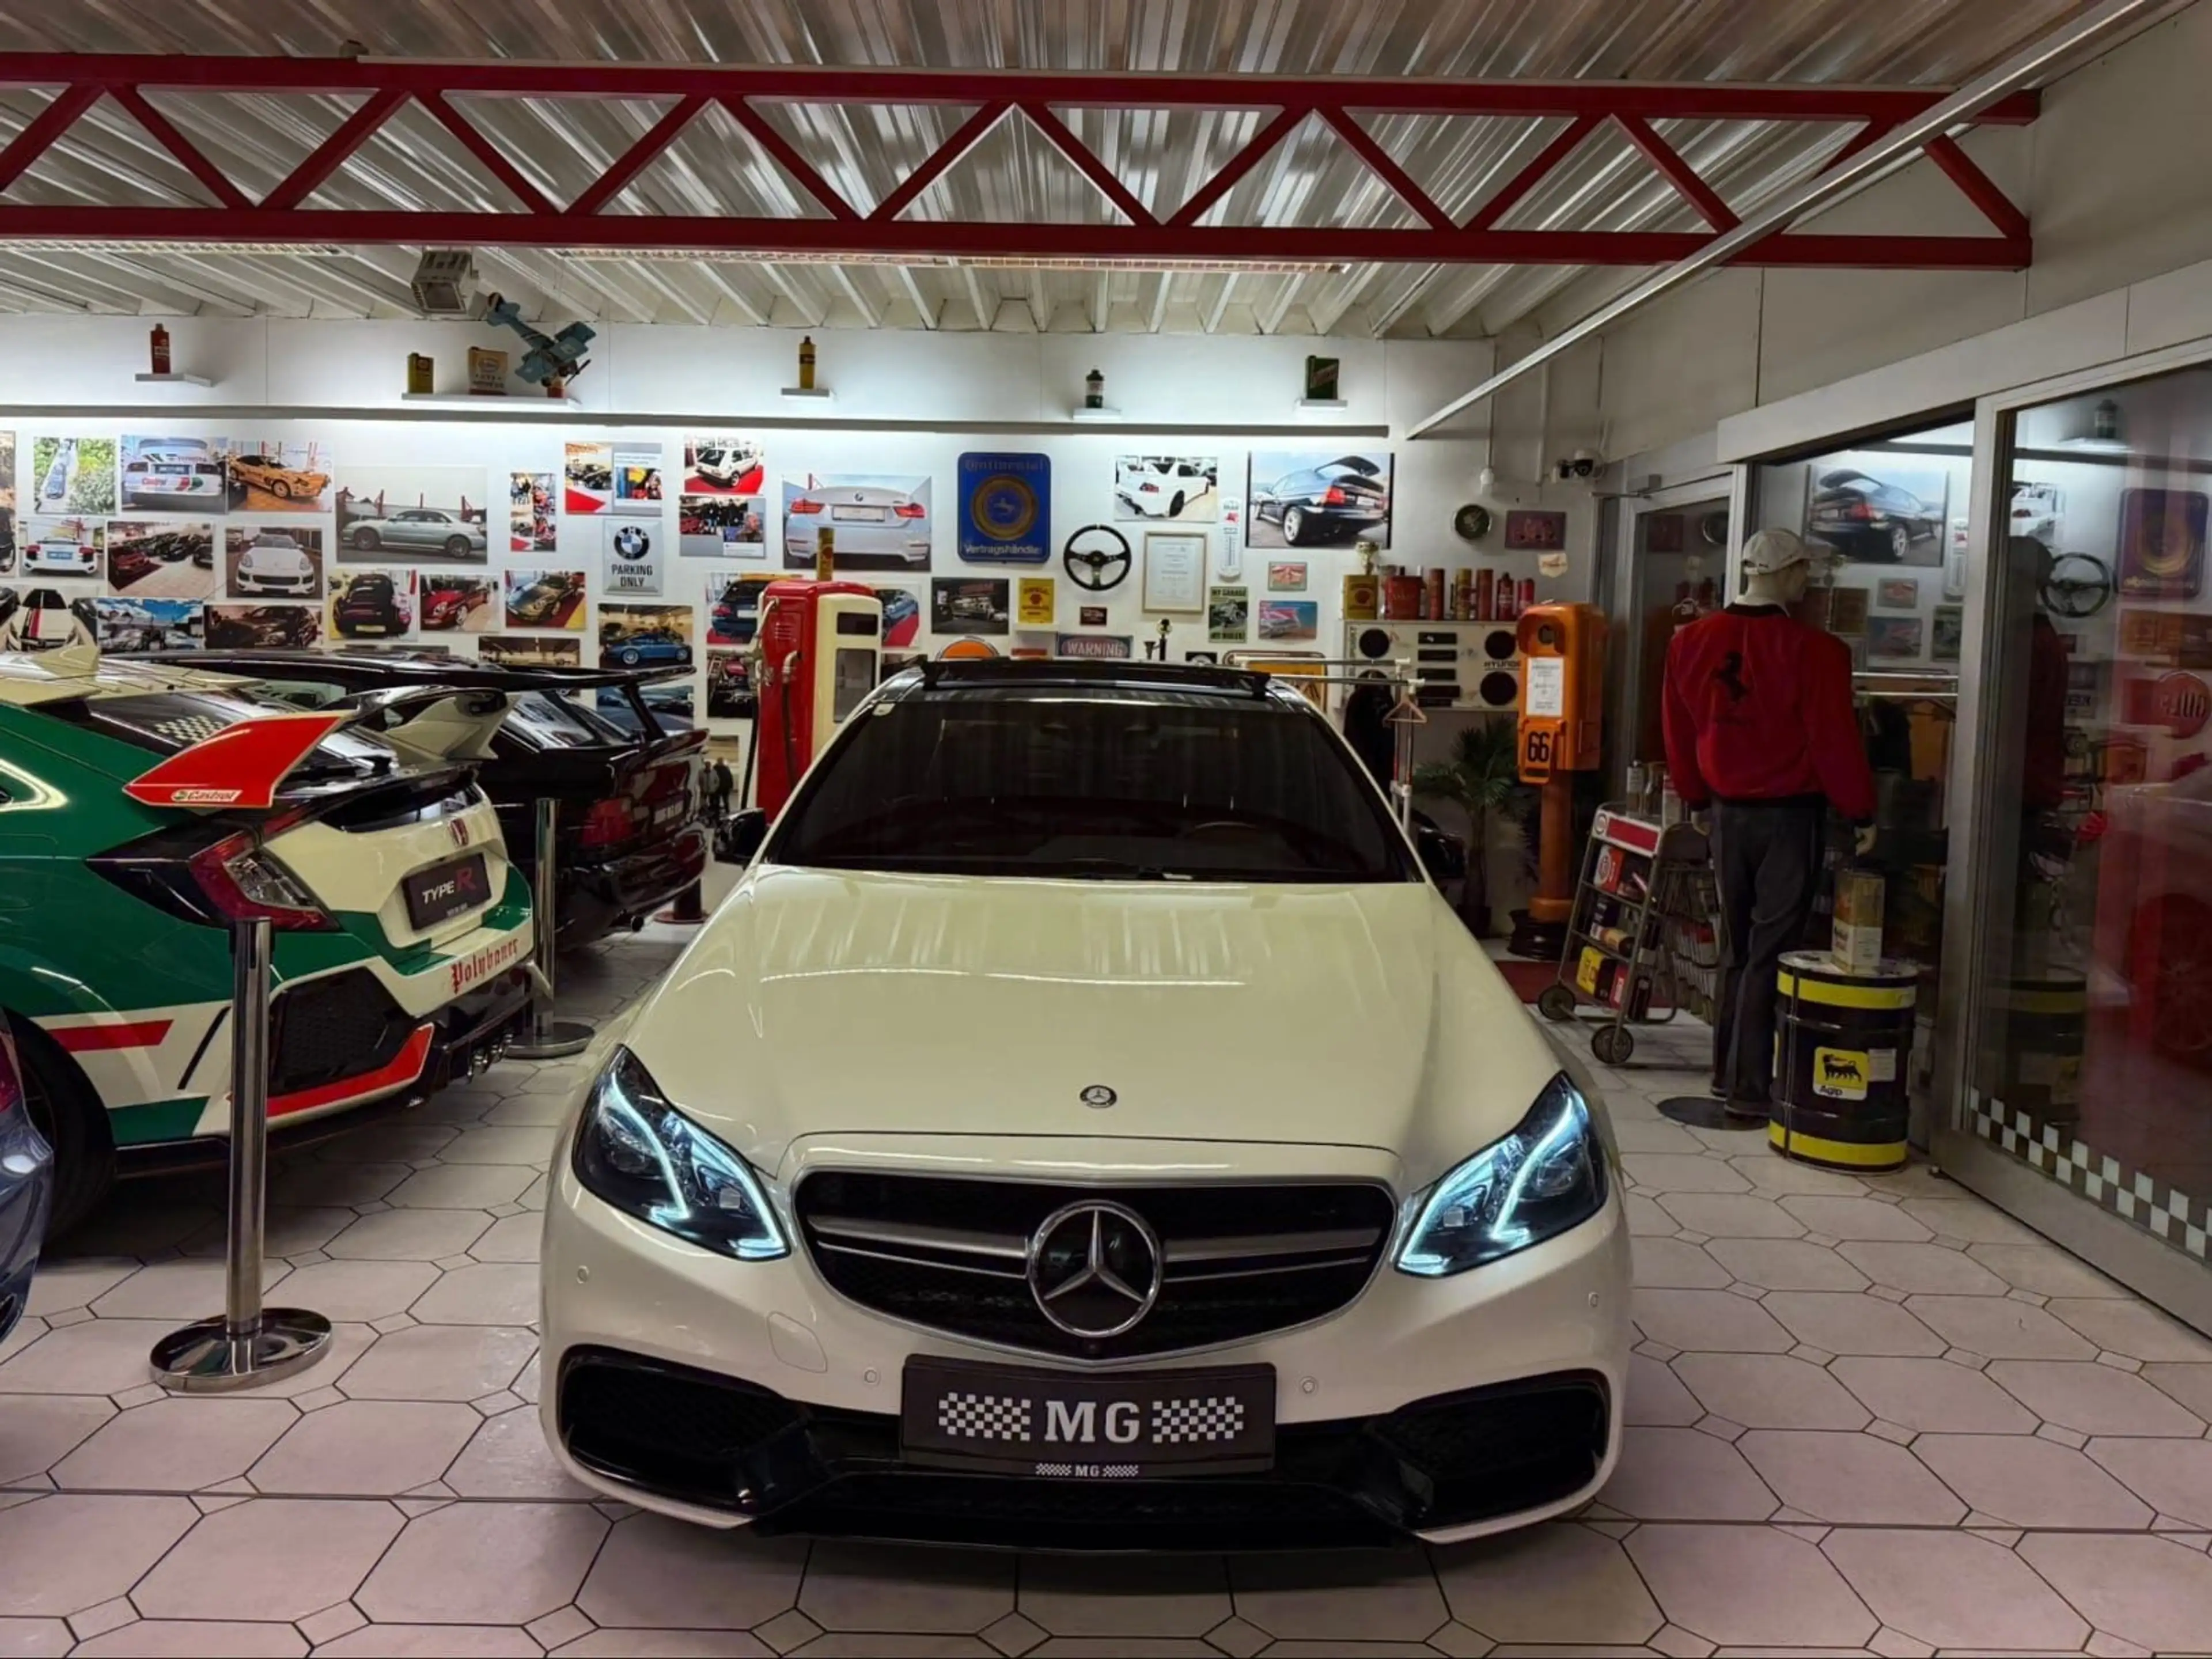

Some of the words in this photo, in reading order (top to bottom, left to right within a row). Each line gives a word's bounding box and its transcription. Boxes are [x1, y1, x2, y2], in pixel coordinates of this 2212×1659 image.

[611, 564, 653, 575] PARKING
[620, 576, 645, 587] ONLY
[1066, 641, 1124, 657] WARNING
[1528, 731, 1550, 762] 66
[187, 790, 237, 801] Castrol
[422, 881, 455, 904] TYPE
[456, 867, 477, 892] R
[1044, 1400, 1140, 1442] MG
[1075, 1465, 1100, 1478] MG
